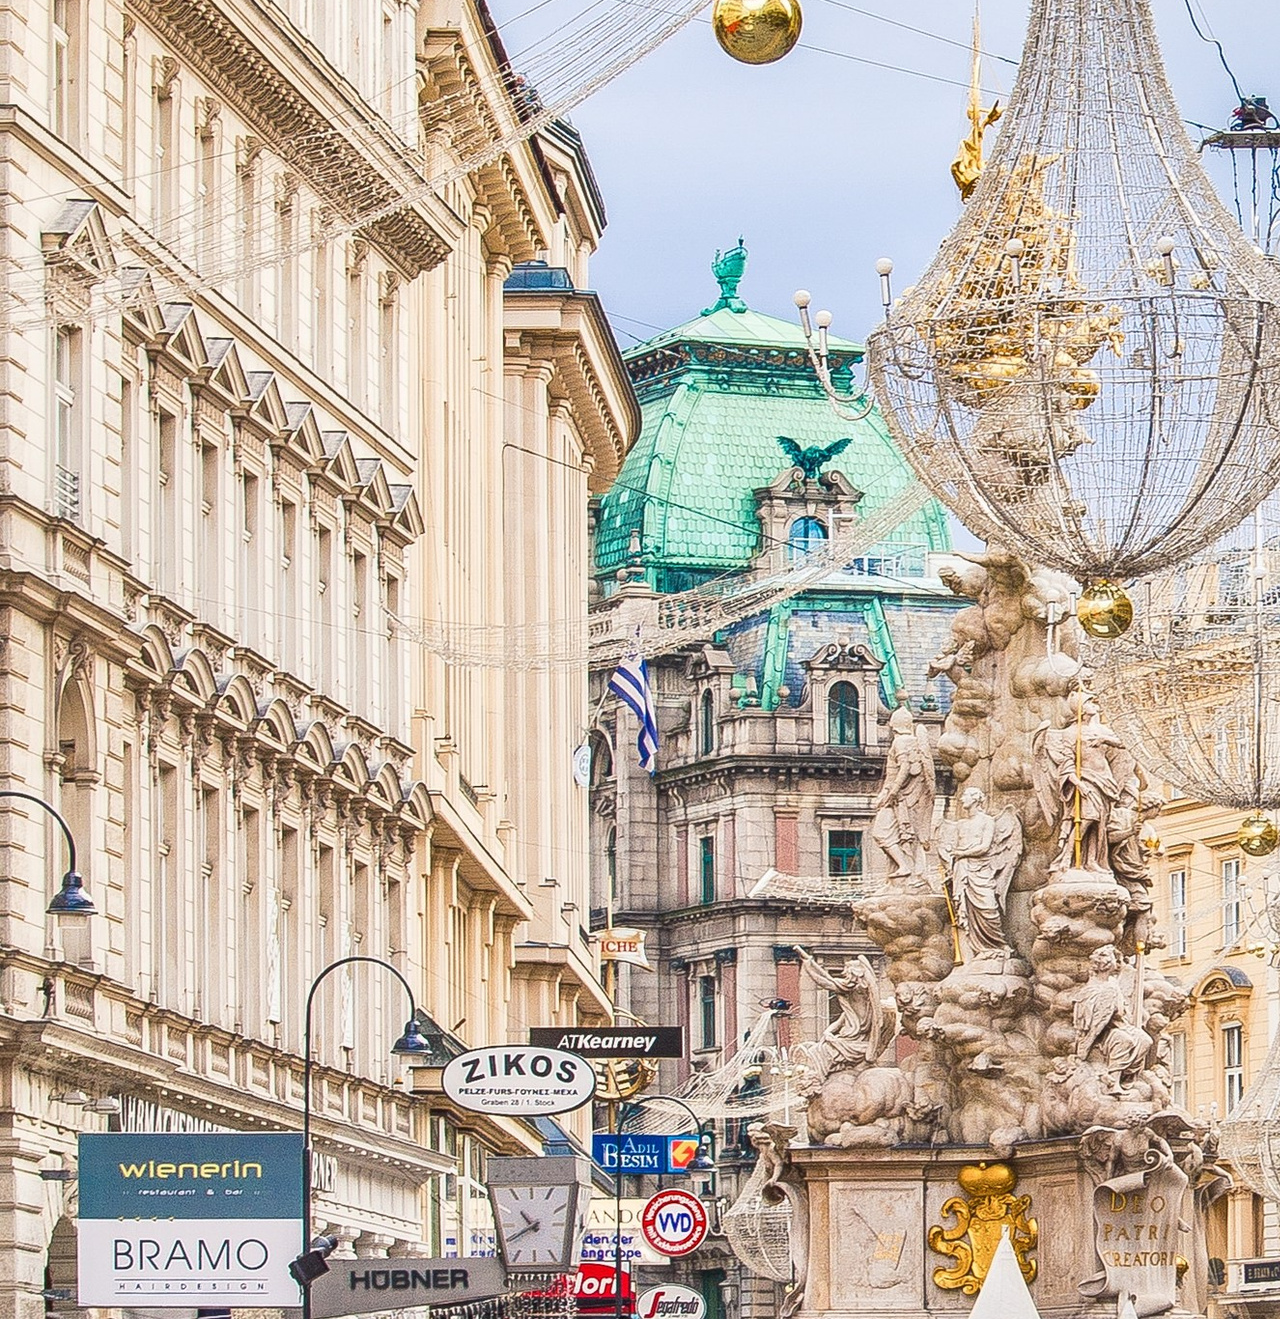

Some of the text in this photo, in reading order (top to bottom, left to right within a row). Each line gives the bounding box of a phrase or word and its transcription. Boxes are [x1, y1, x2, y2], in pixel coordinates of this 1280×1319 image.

[461, 1053, 577, 1085] ZIKOS
[481, 1098, 509, 1107] Graben
[510, 1098, 520, 1107] 28
[534, 1098, 555, 1107] Stock
[119, 1160, 262, 1179] wienerin
[138, 1188, 243, 1196] restaurant & bar
[1110, 1192, 1165, 1213] DEO
[658, 1212, 692, 1233] VVD
[1103, 1223, 1170, 1241] PATRI
[113, 1239, 268, 1270] BRAMO
[1102, 1249, 1176, 1267] CREATORI
[350, 1269, 470, 1290] HÜBNER
[643, 1291, 700, 1319] Segafredo
